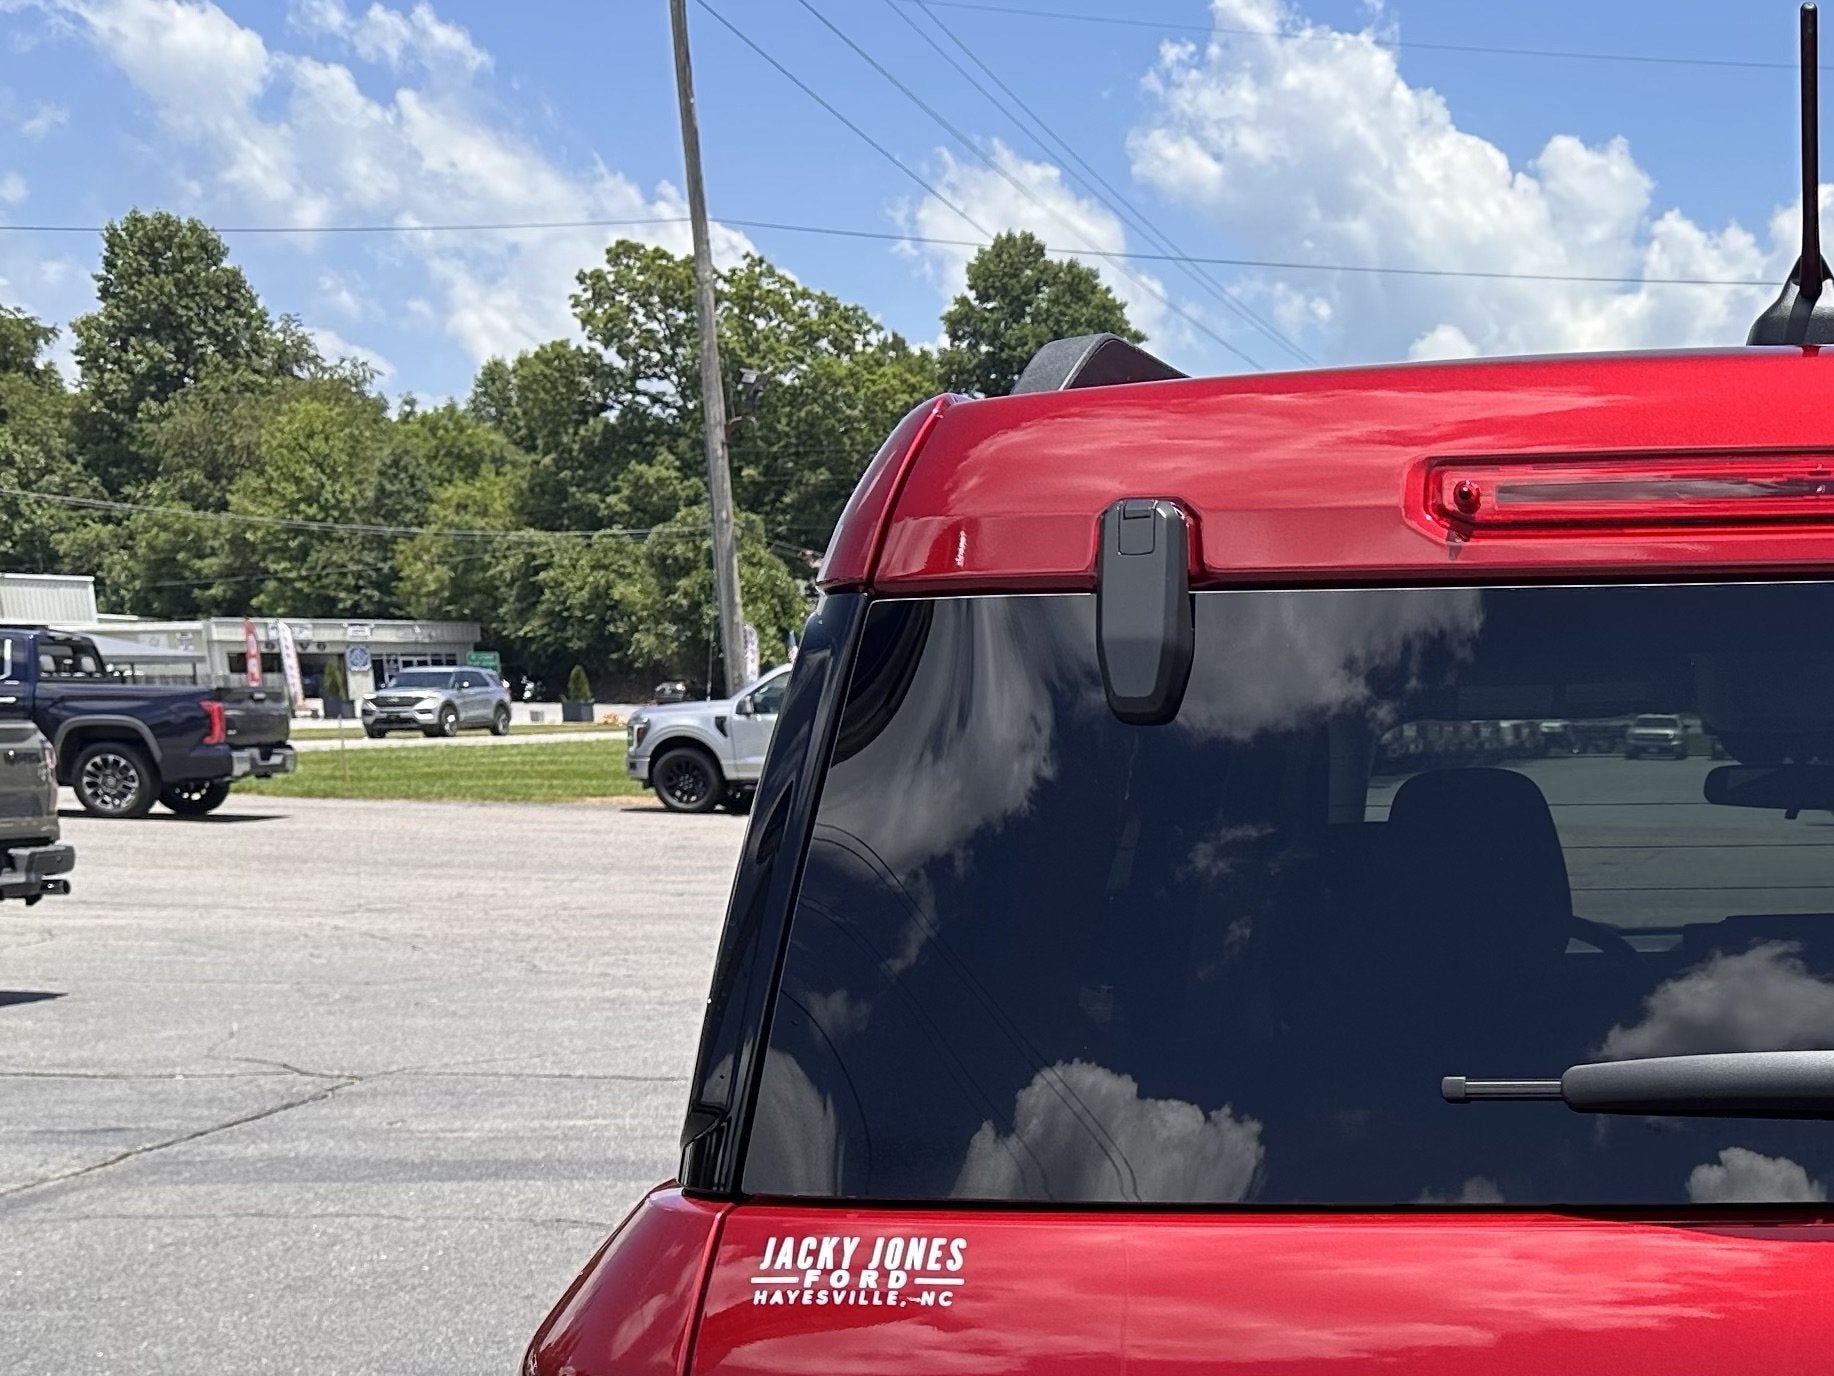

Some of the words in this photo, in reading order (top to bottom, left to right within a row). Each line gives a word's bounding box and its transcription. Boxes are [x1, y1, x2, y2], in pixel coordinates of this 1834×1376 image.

[759, 1236, 860, 1270] JACKY
[868, 1236, 967, 1272] JONES
[803, 1269, 908, 1289] FORD
[753, 1289, 907, 1307] HAYESVILLE,
[920, 1291, 953, 1307] NC
